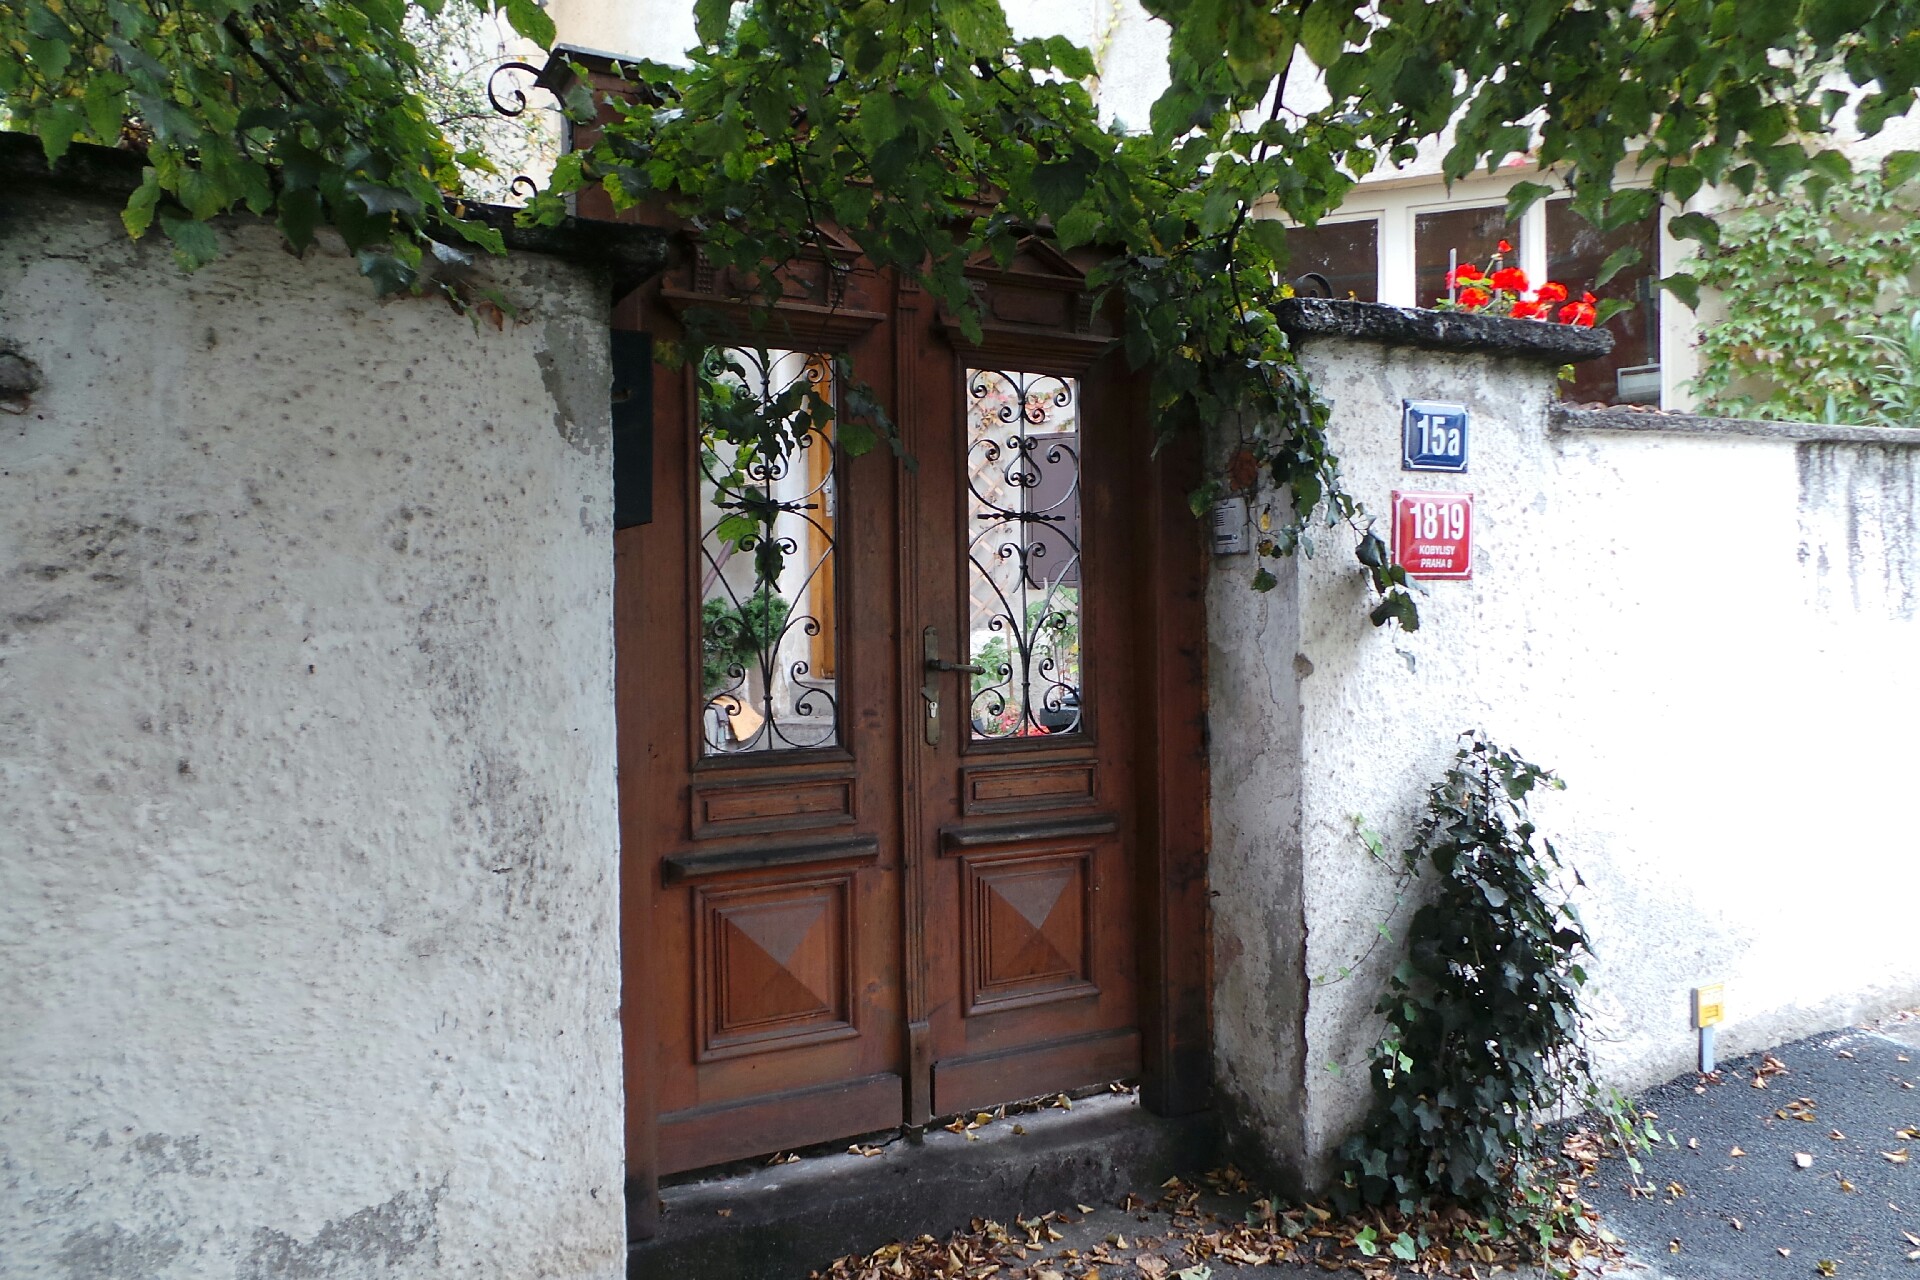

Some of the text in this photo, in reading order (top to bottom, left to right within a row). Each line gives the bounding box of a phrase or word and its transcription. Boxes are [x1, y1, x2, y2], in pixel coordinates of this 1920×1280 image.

[1417, 414, 1460, 456] 15a
[1410, 502, 1464, 540] 1819
[1419, 545, 1455, 554] KOBYLISY
[1420, 558, 1452, 568] PRAHA 8
